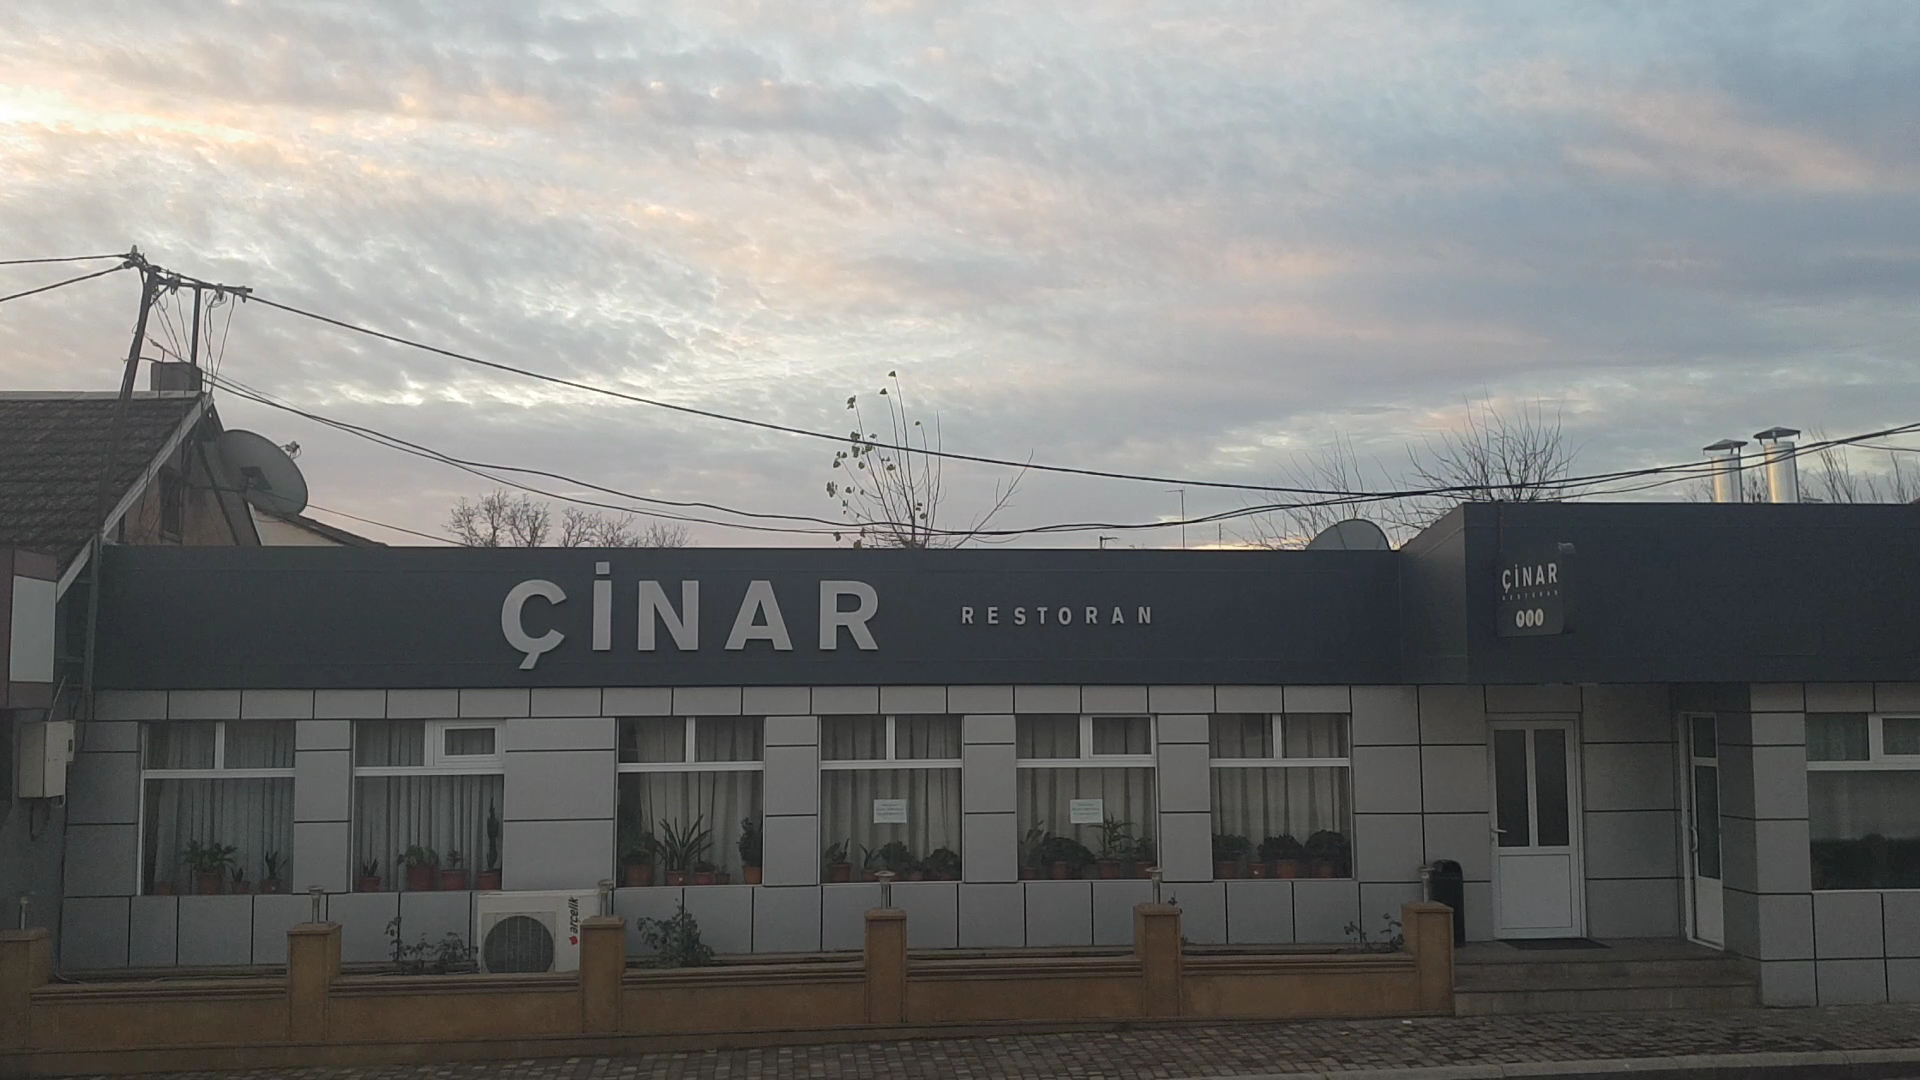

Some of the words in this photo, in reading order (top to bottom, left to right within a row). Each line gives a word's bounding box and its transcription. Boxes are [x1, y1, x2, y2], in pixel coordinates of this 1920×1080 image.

[1502, 563, 1557, 593] ÇİNAR
[501, 561, 879, 670] ÇİNAR
[961, 606, 1151, 625] RESTORAN
